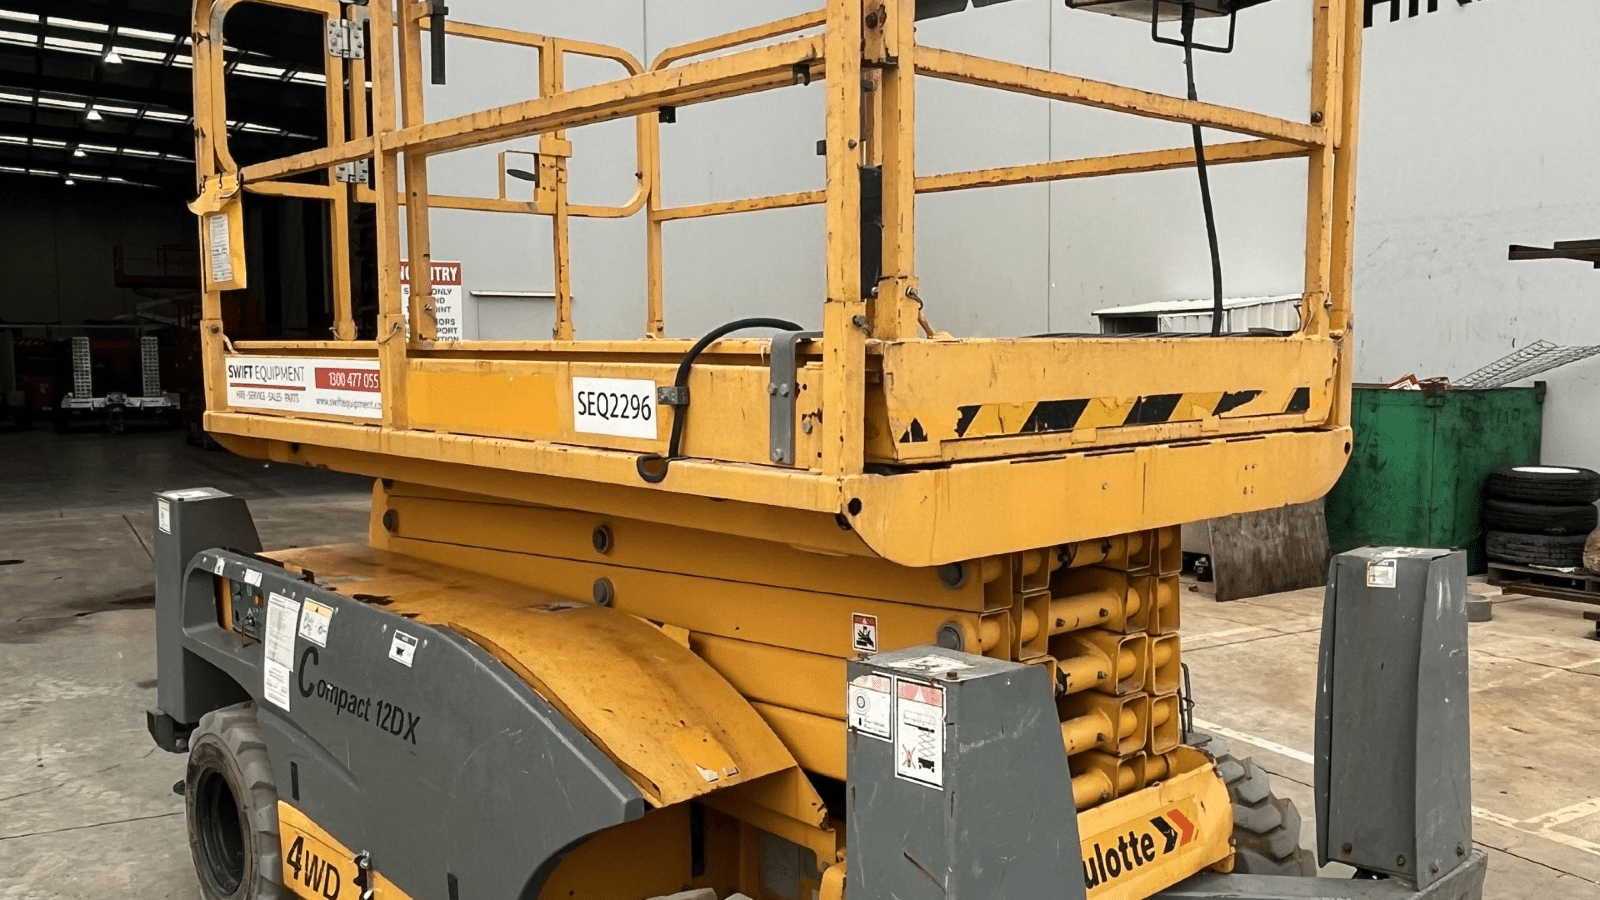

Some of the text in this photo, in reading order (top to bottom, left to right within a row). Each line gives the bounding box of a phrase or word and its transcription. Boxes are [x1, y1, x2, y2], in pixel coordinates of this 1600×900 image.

[431, 266, 457, 282] TRY
[437, 318, 456, 326] ORS
[437, 327, 458, 335] PORT
[228, 364, 305, 383] SWIFT EQUIPMENT
[328, 371, 379, 389] 1300 477 055
[578, 391, 652, 420] SEQ2296
[298, 646, 371, 722] Compact
[376, 700, 421, 745] 12DX
[286, 835, 341, 900] 4WD
[1083, 830, 1156, 889] ulotte
